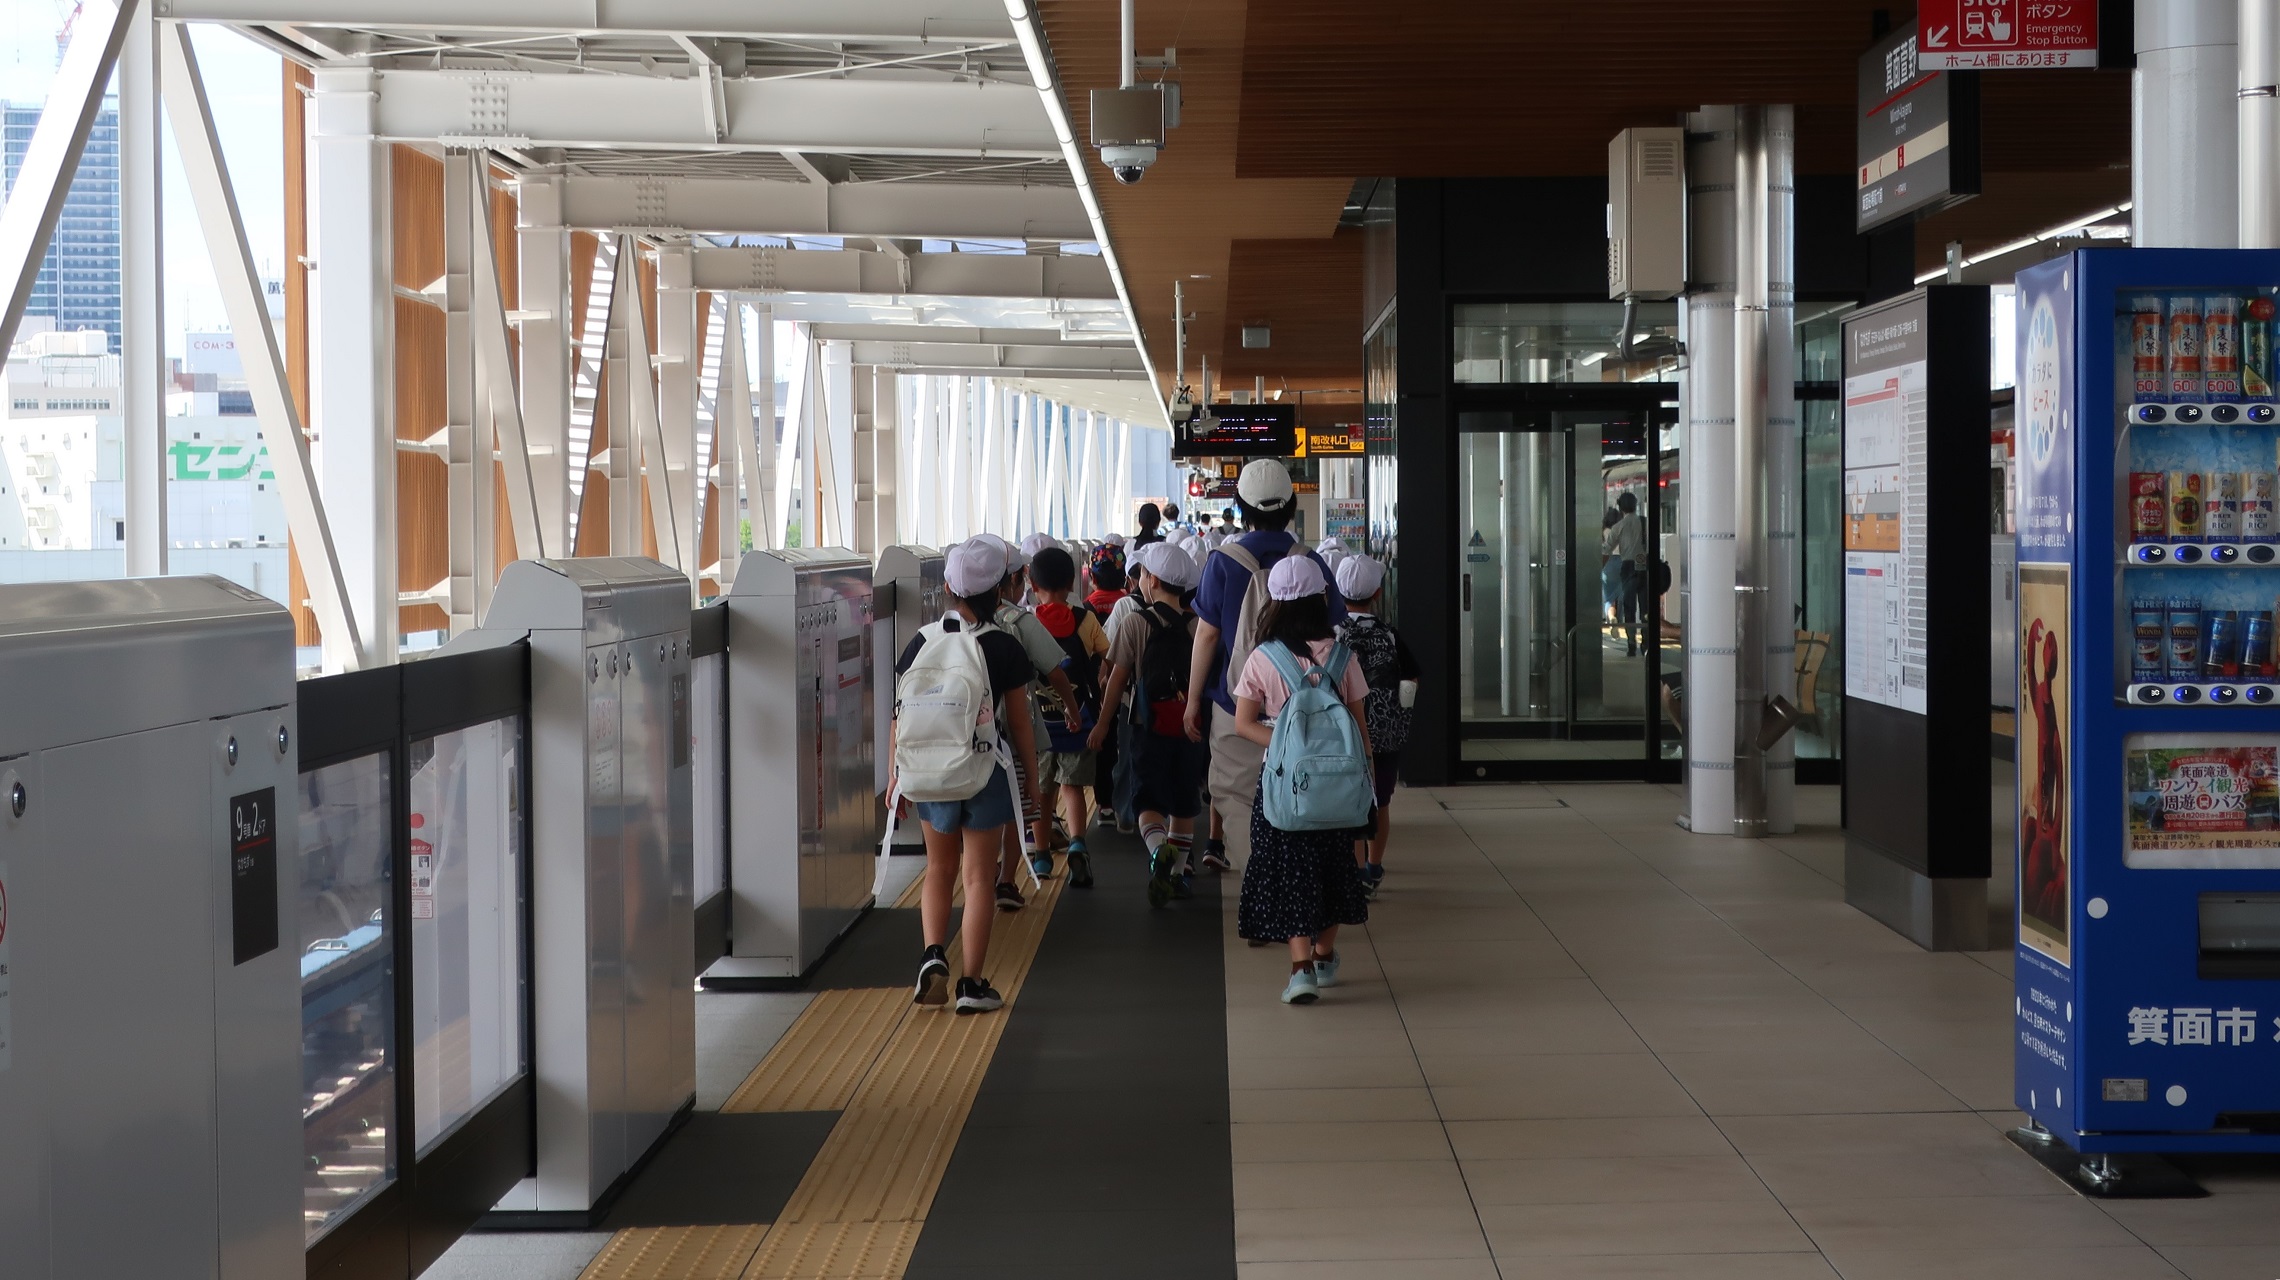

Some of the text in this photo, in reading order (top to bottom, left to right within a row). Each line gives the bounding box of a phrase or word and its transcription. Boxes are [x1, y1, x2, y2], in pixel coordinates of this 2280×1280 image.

[2026, 4, 2072, 19] ボタン
[2026, 24, 2082, 34] Emergency
[2026, 35, 2088, 46] Stop Button
[1945, 52, 2071, 67] ホーム柵にあります
[268, 281, 286, 295] 萬
[1179, 422, 1187, 440] 1
[1310, 435, 1348, 445] 南改札口
[2136, 627, 2162, 636] WONDA
[2173, 627, 2198, 636] WONDA
[2180, 765, 2229, 778] 箕面滝道
[2160, 779, 2250, 794] ワンウェイ観光
[2127, 1006, 2257, 1046] 箕面市
